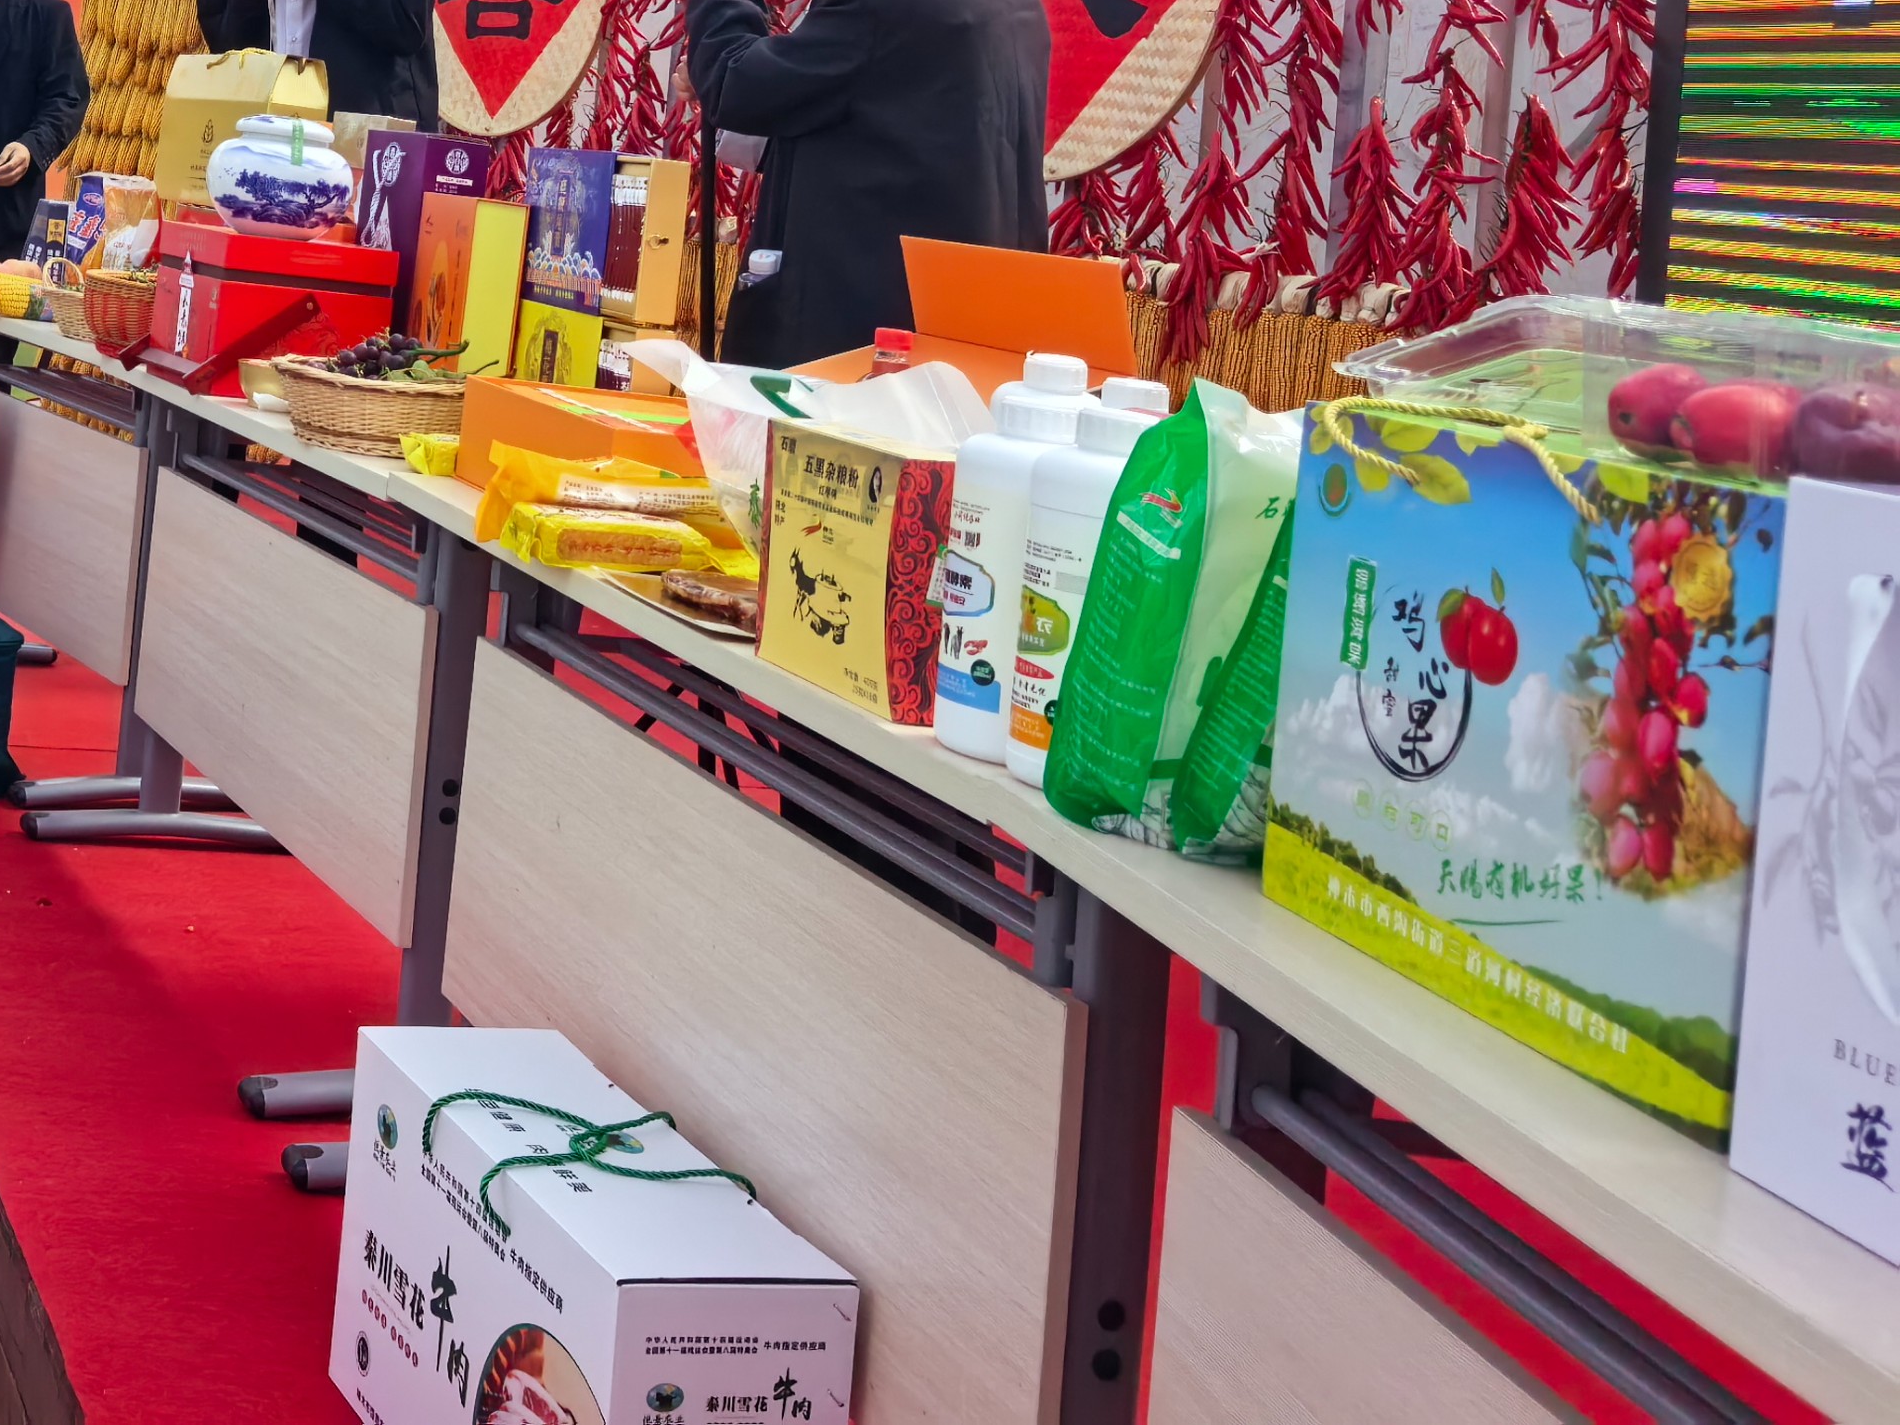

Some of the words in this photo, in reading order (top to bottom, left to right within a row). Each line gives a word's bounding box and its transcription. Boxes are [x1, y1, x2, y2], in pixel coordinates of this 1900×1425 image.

[804, 455, 859, 489] 五黑杂粮粉
[1391, 589, 1450, 770] 鸡心果
[1839, 1102, 1895, 1193] 蓝
[364, 1230, 425, 1331] 秦川雪花
[510, 1248, 565, 1314] 牛肉指定供应商
[763, 1341, 826, 1351] 牛肉指定供应商
[705, 1395, 768, 1413] 秦川雪花
[773, 1367, 812, 1420] 牛肉
